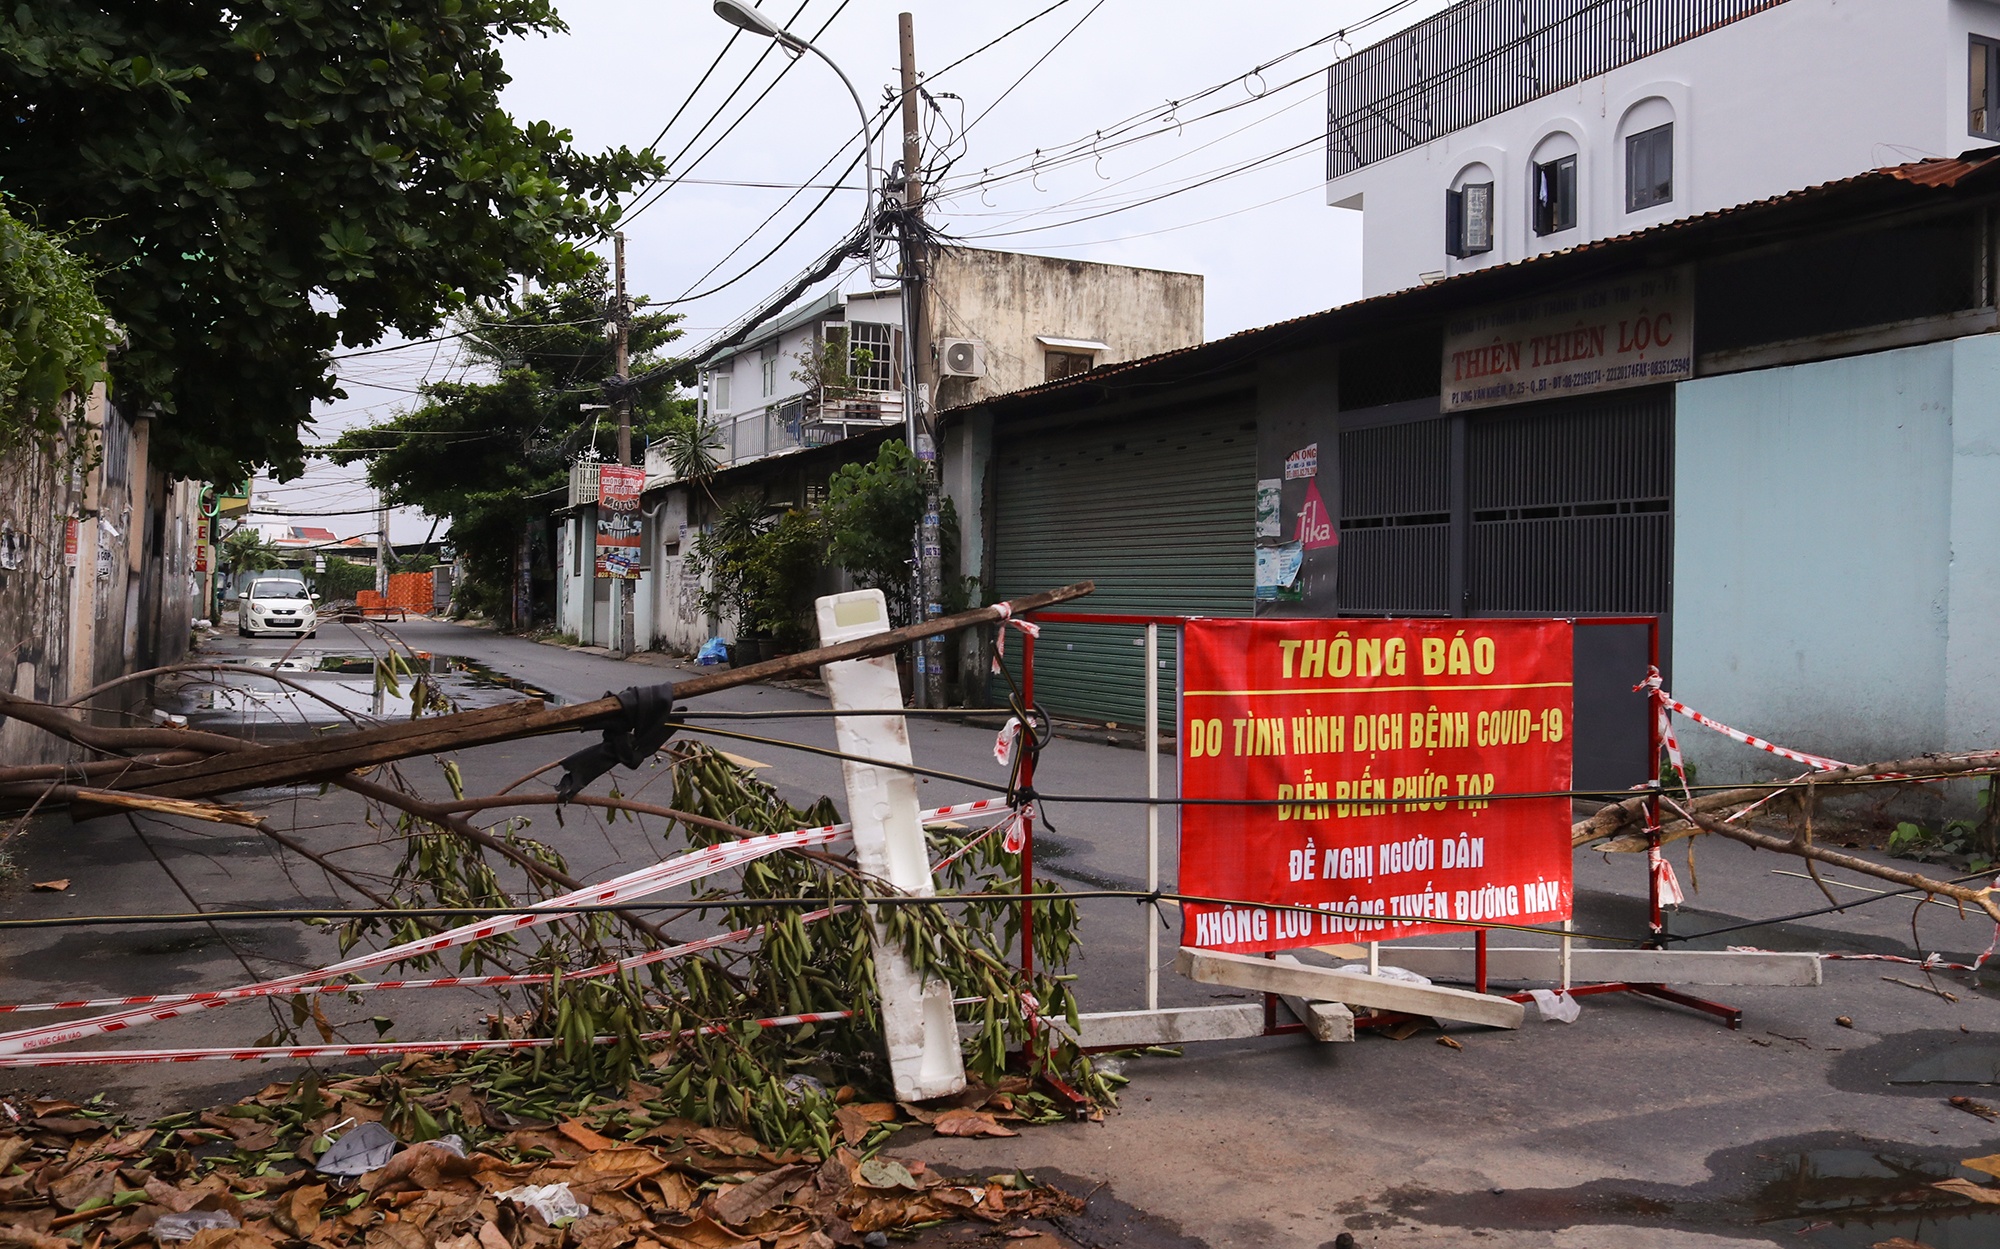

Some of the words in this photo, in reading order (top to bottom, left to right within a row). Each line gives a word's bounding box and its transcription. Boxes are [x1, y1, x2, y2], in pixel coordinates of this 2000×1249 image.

[1452, 336, 1522, 381] THIÊN
[1530, 320, 1607, 368] THIÊN
[1618, 307, 1672, 360] LỘC
[1278, 631, 1406, 679] THÔNG
[1422, 630, 1496, 676] BÁO
[1190, 718, 1223, 758] DO
[1232, 710, 1286, 756] TÌNH
[1292, 709, 1346, 754] HÌNH
[1354, 712, 1404, 759] DỊCH
[1410, 706, 1469, 757] BỆNH
[1477, 708, 1563, 746] COVID-19
[1278, 768, 1330, 821] DIỄN
[1336, 766, 1386, 818] BIẾN
[1392, 768, 1448, 814] PHỨC
[1456, 773, 1495, 818] TẠP
[1289, 836, 1316, 882] ĐỀ
[1322, 844, 1374, 884] NGHỊ
[1379, 835, 1434, 876] NGƯỜI
[1442, 831, 1484, 870] DÂN
[1195, 904, 1268, 947] KHÔNG
[1318, 895, 1386, 935] THÔNG
[1390, 880, 1449, 928] TUYẾN
[1454, 882, 1520, 922] ĐƯỜNG
[1524, 876, 1559, 914] NÀY
